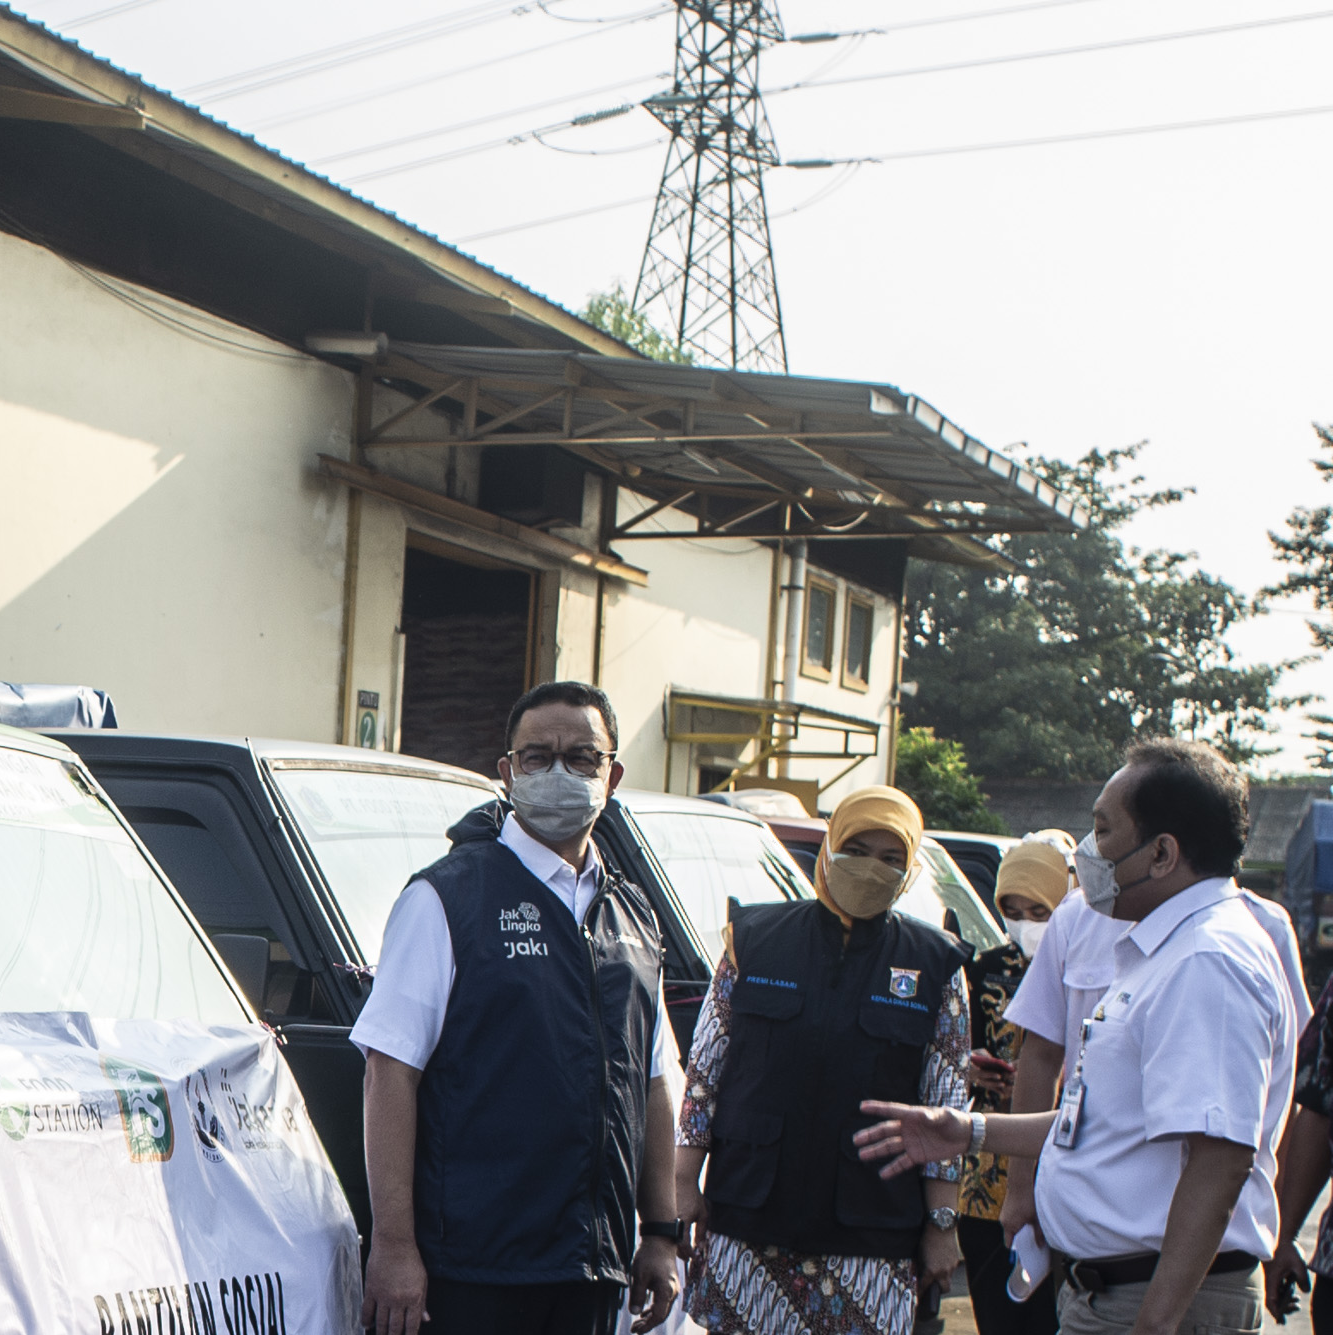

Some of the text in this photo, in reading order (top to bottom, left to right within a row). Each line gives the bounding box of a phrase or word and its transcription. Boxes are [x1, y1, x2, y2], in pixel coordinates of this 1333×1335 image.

[363, 716, 372, 748] 2
[498, 908, 520, 920] Jak
[500, 919, 542, 934] Lingko
[32, 1102, 104, 1133] STATION
